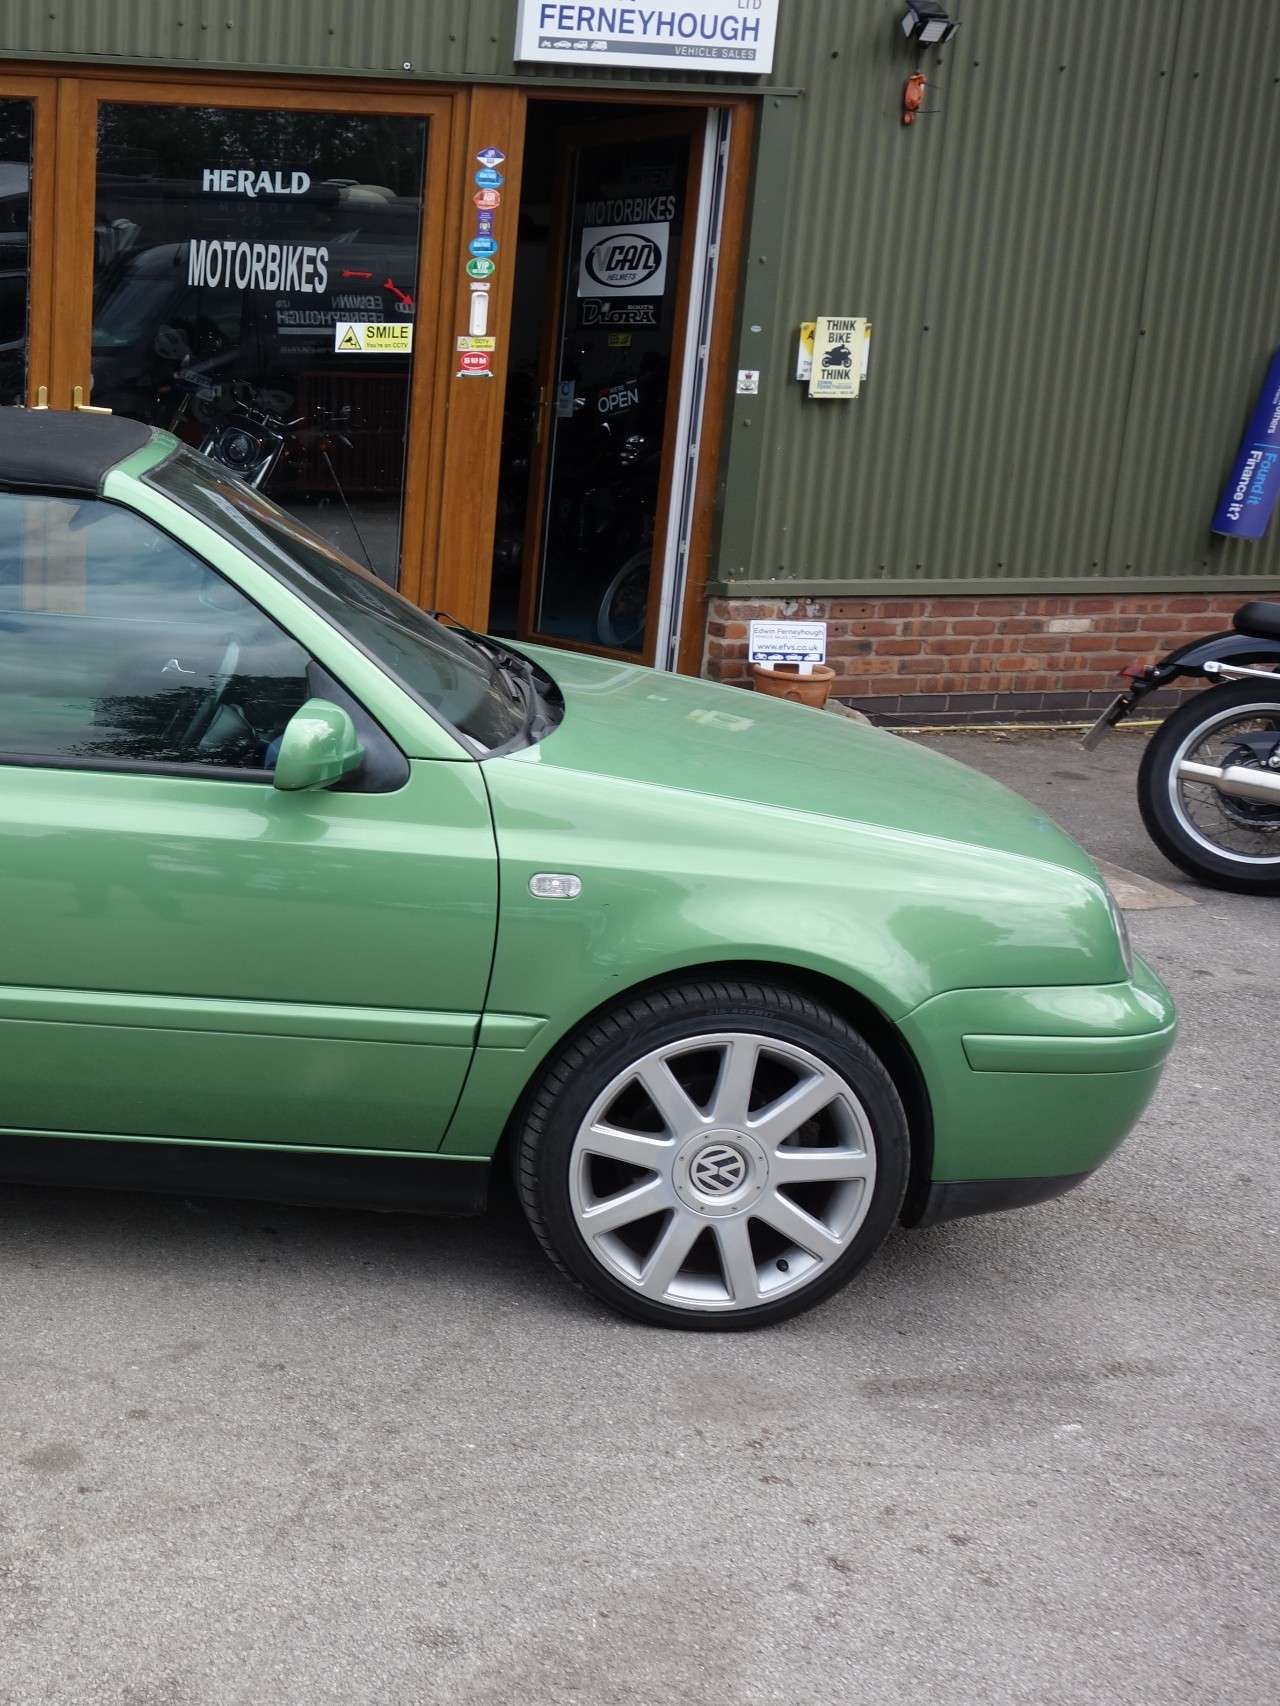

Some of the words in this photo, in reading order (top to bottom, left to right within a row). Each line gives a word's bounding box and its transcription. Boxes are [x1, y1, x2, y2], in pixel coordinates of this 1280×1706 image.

[538, 3, 761, 43] FERNEYHOUGH
[674, 46, 718, 58] VEHICLE
[721, 48, 755, 60] SALES
[202, 168, 311, 198] HERALD
[584, 195, 677, 224] MOTORBIKES
[187, 239, 329, 294] MOTORBIKES
[366, 325, 409, 339] SMILE
[826, 319, 857, 332] THINK
[828, 332, 852, 343] BIKE
[821, 368, 851, 380] THINK
[597, 387, 640, 413] OPEN
[1232, 450, 1264, 501] Finance
[1250, 452, 1278, 494] Found
[1226, 502, 1244, 521] it?
[1246, 495, 1263, 506] it
